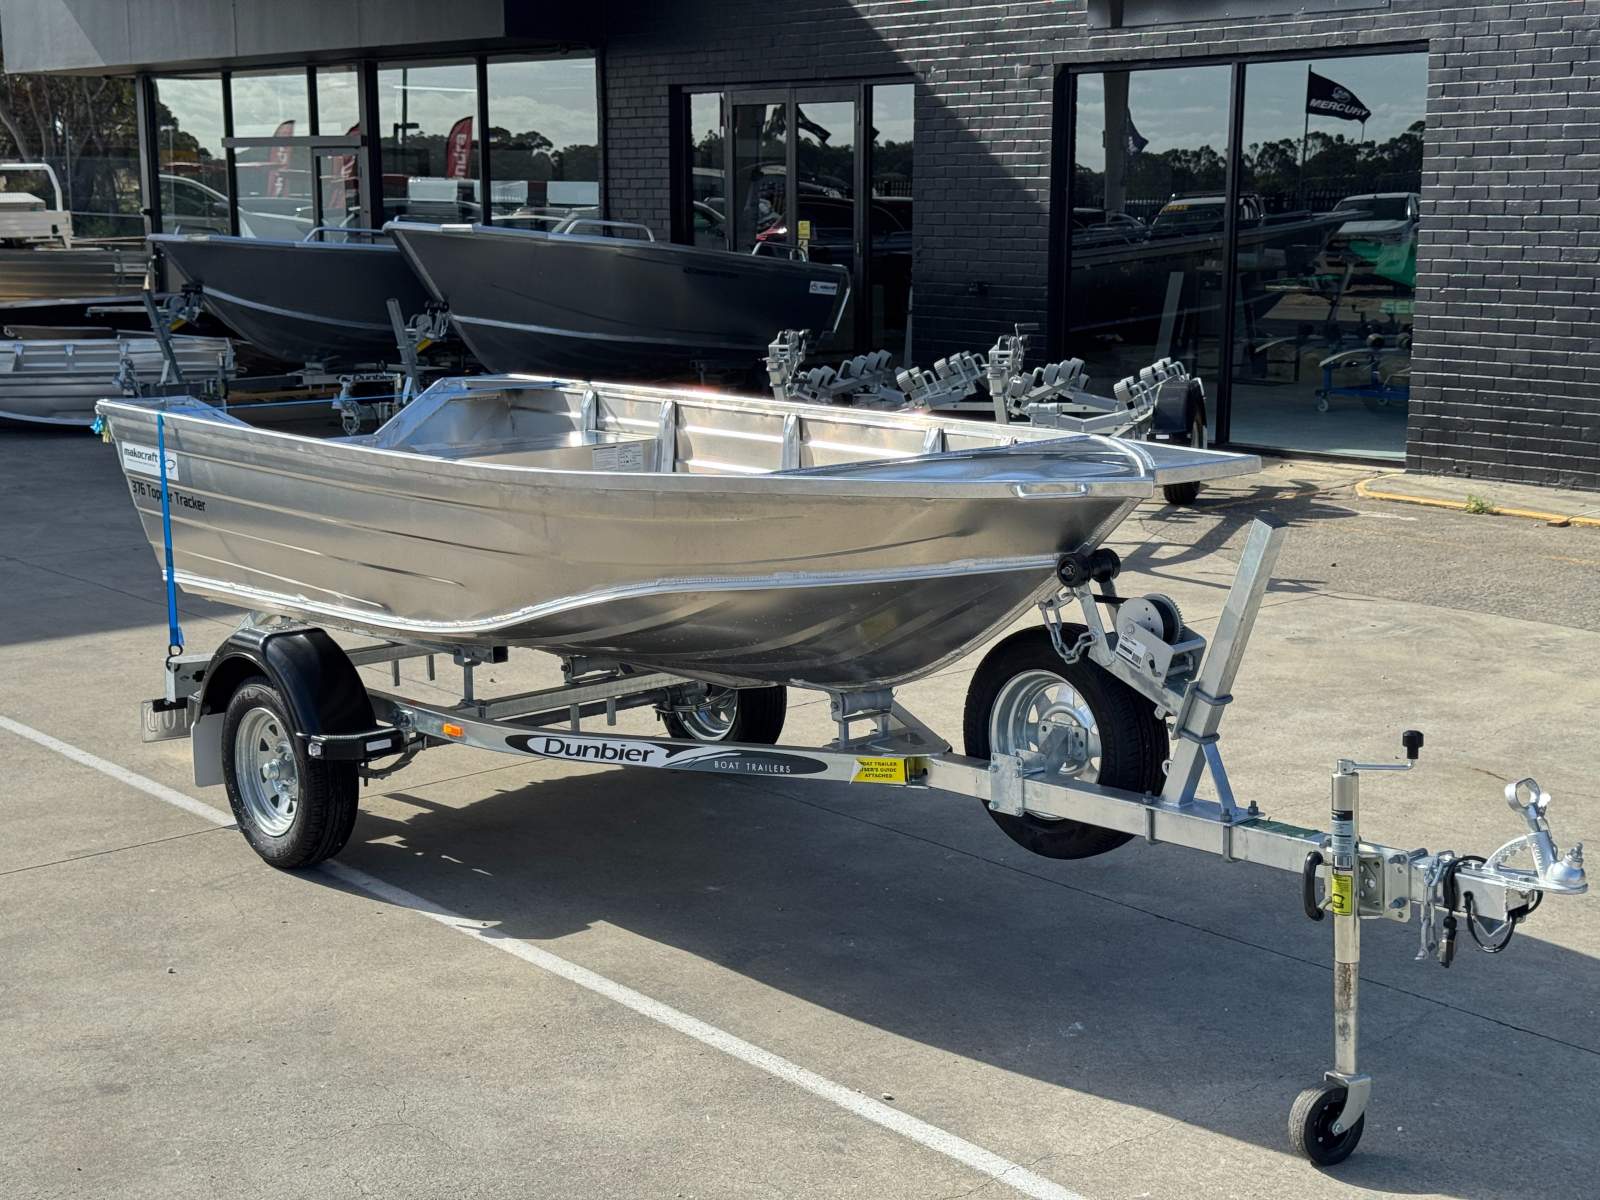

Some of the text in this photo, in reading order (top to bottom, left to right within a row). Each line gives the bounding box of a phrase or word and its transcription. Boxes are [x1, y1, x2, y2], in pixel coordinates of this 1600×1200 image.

[1309, 98, 1368, 116] MERCURY
[123, 447, 159, 463] makocraft
[131, 480, 206, 512] 376 Topr Tracker
[544, 738, 655, 762] Dunbier
[714, 760, 792, 774] BOAT TRAILERS
